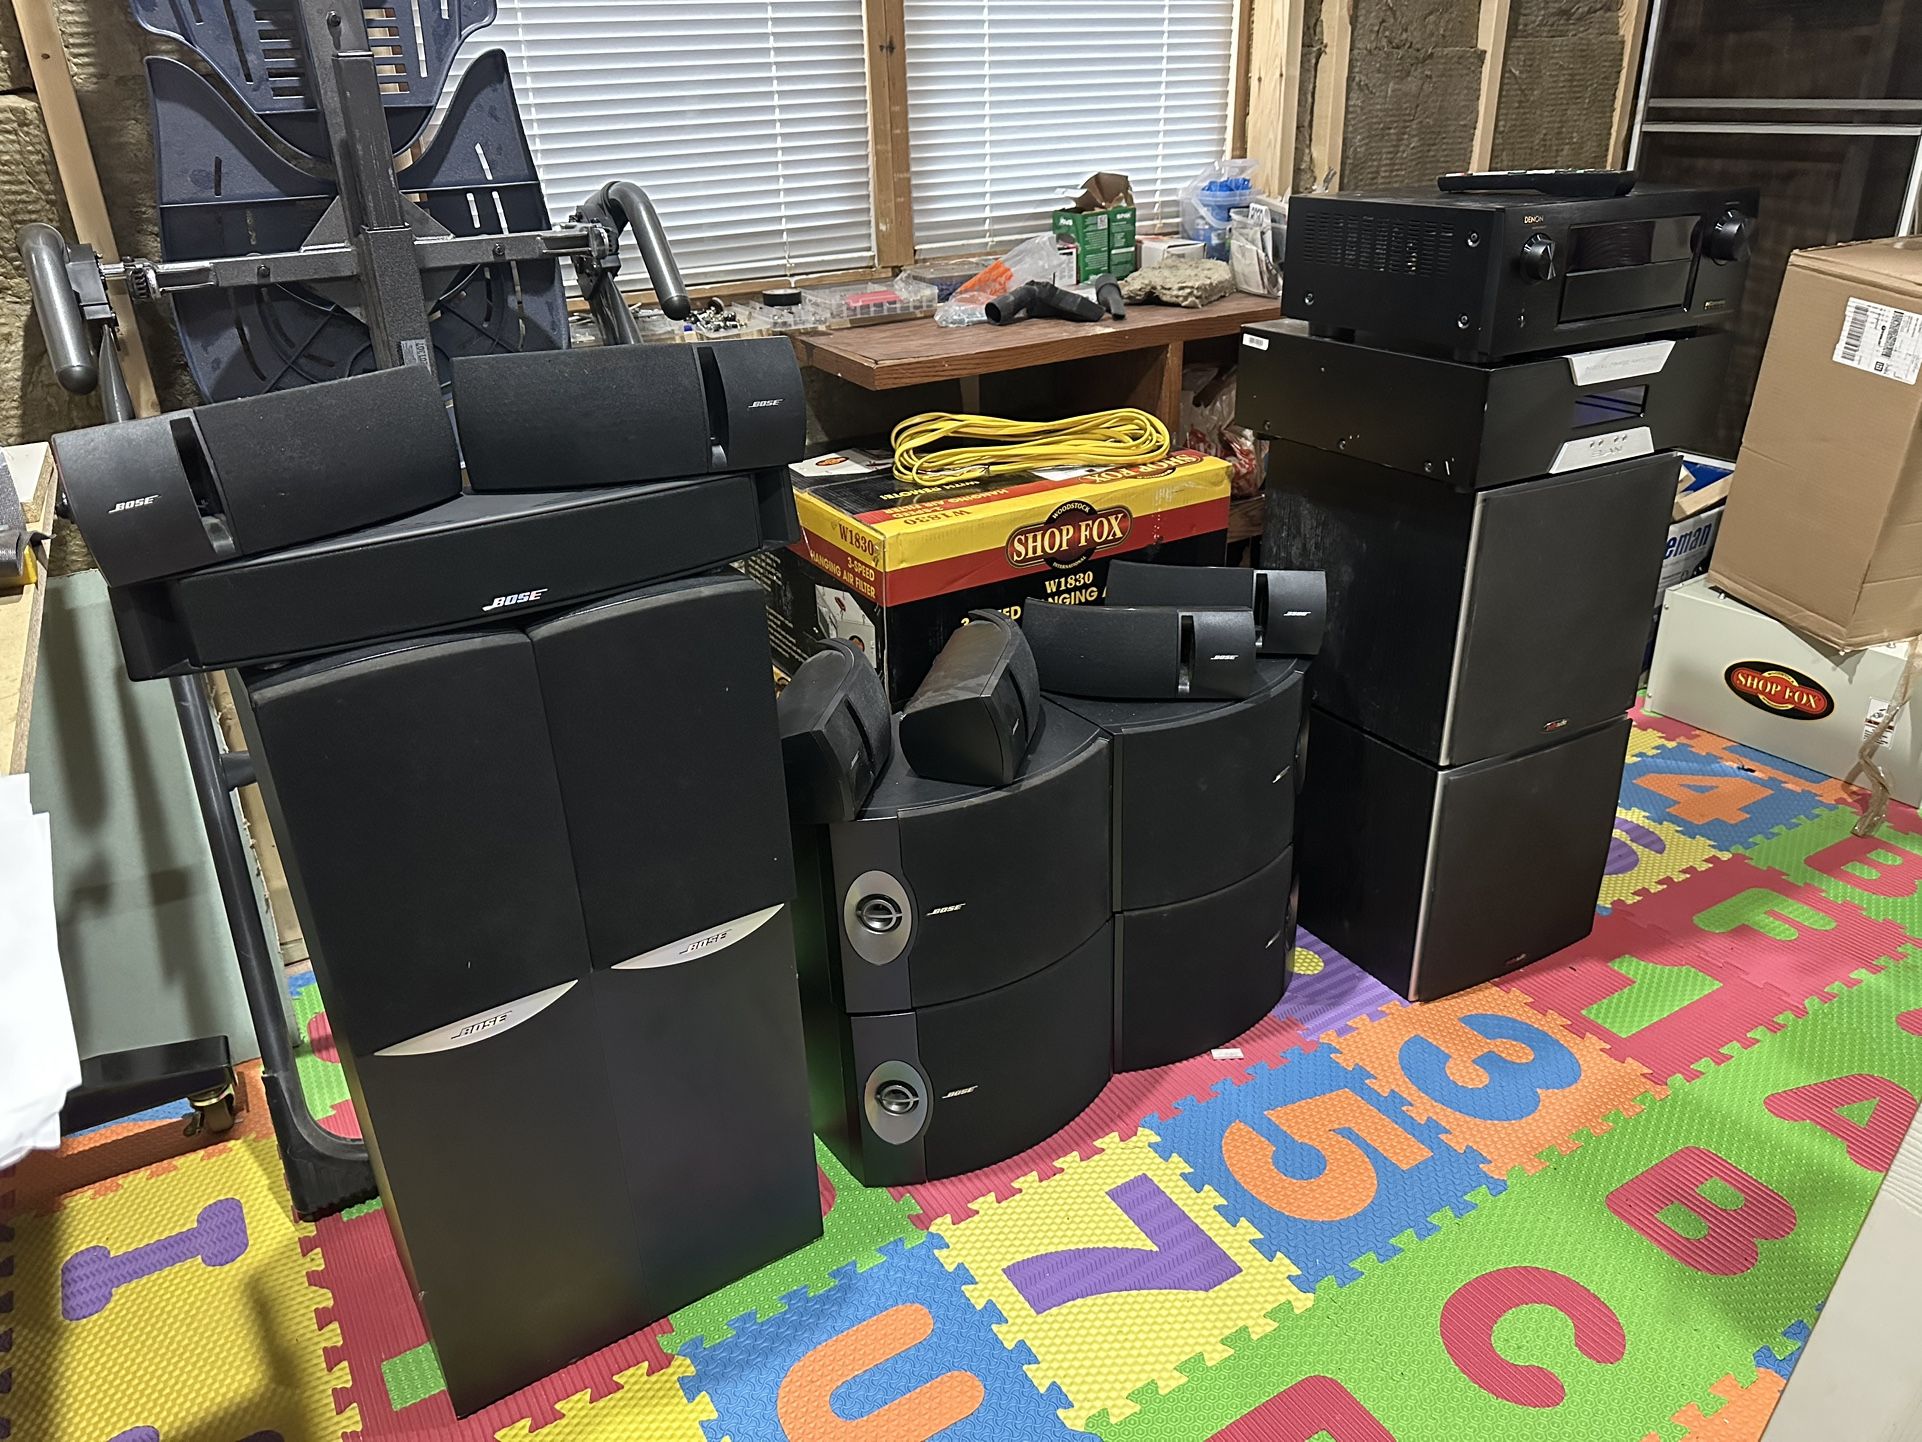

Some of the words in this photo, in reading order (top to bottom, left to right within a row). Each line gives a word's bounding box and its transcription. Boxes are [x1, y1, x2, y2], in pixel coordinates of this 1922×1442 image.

[1523, 214, 1544, 224] DENON
[748, 399, 784, 408] BOSE
[108, 495, 162, 514] BOSE
[1052, 502, 1090, 519] WOODSTOCK
[904, 510, 972, 526] W1830
[838, 523, 875, 556] W1830
[1013, 525, 1074, 562] SHOP
[1078, 513, 1124, 547] FOX
[1664, 523, 1712, 560] eman
[810, 549, 842, 577] HANGING
[842, 571, 854, 585] AIR
[855, 577, 876, 599] FILTER
[847, 557, 875, 582] 3-SPEED
[1045, 571, 1093, 594] W1830
[482, 589, 549, 612] BOSE
[1736, 672, 1781, 695] SHOP
[1784, 686, 1819, 709] FOX
[926, 903, 966, 916] BOSE
[679, 928, 733, 955] BOSE
[450, 1010, 513, 1041] BOSE
[942, 1085, 979, 1099] BOSE
